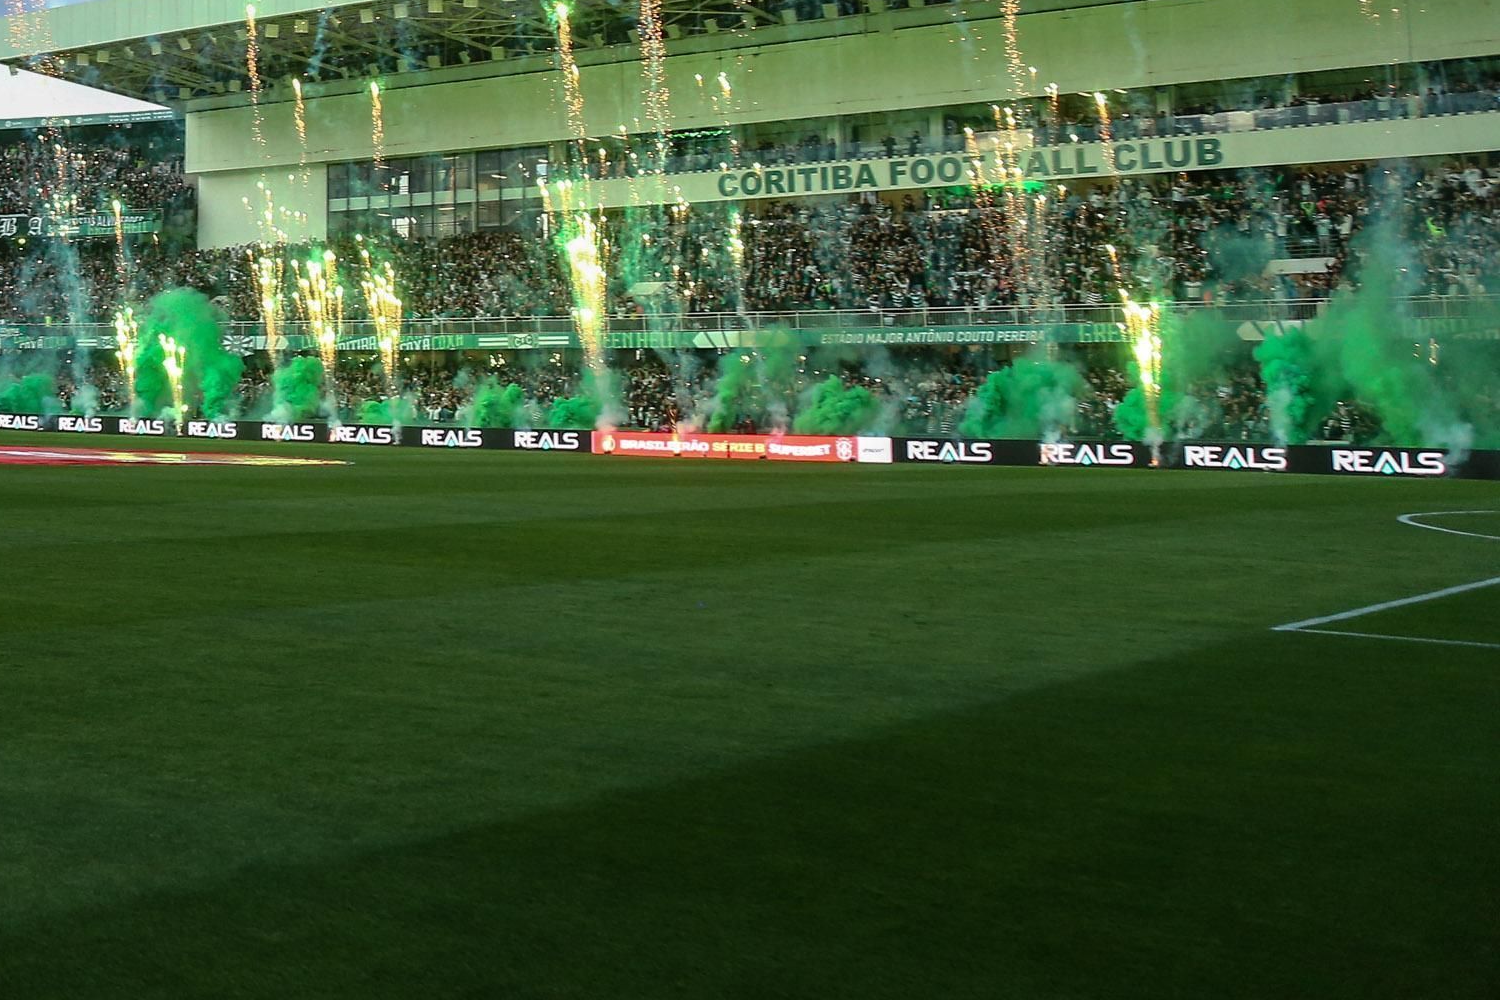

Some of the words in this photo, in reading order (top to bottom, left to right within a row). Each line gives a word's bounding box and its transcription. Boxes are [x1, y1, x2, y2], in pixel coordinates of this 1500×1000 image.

[718, 164, 876, 197] CORITIBA
[889, 147, 1098, 187] FOOTALL
[1114, 137, 1223, 172] CLUB
[866, 333, 904, 344] MAJOR
[906, 328, 955, 343] ANTÔNIO
[956, 331, 995, 342] COUTO
[59, 416, 102, 432] REALS
[119, 419, 164, 434] REALS
[188, 421, 237, 438] REALS
[262, 424, 314, 441] REALS
[337, 426, 392, 443] REALS
[422, 430, 483, 447] REALS
[514, 432, 579, 450] REALS
[906, 440, 993, 463] REALS
[1040, 443, 1134, 466] REALS
[1184, 445, 1287, 470] REALS
[1332, 449, 1446, 475] REALS
